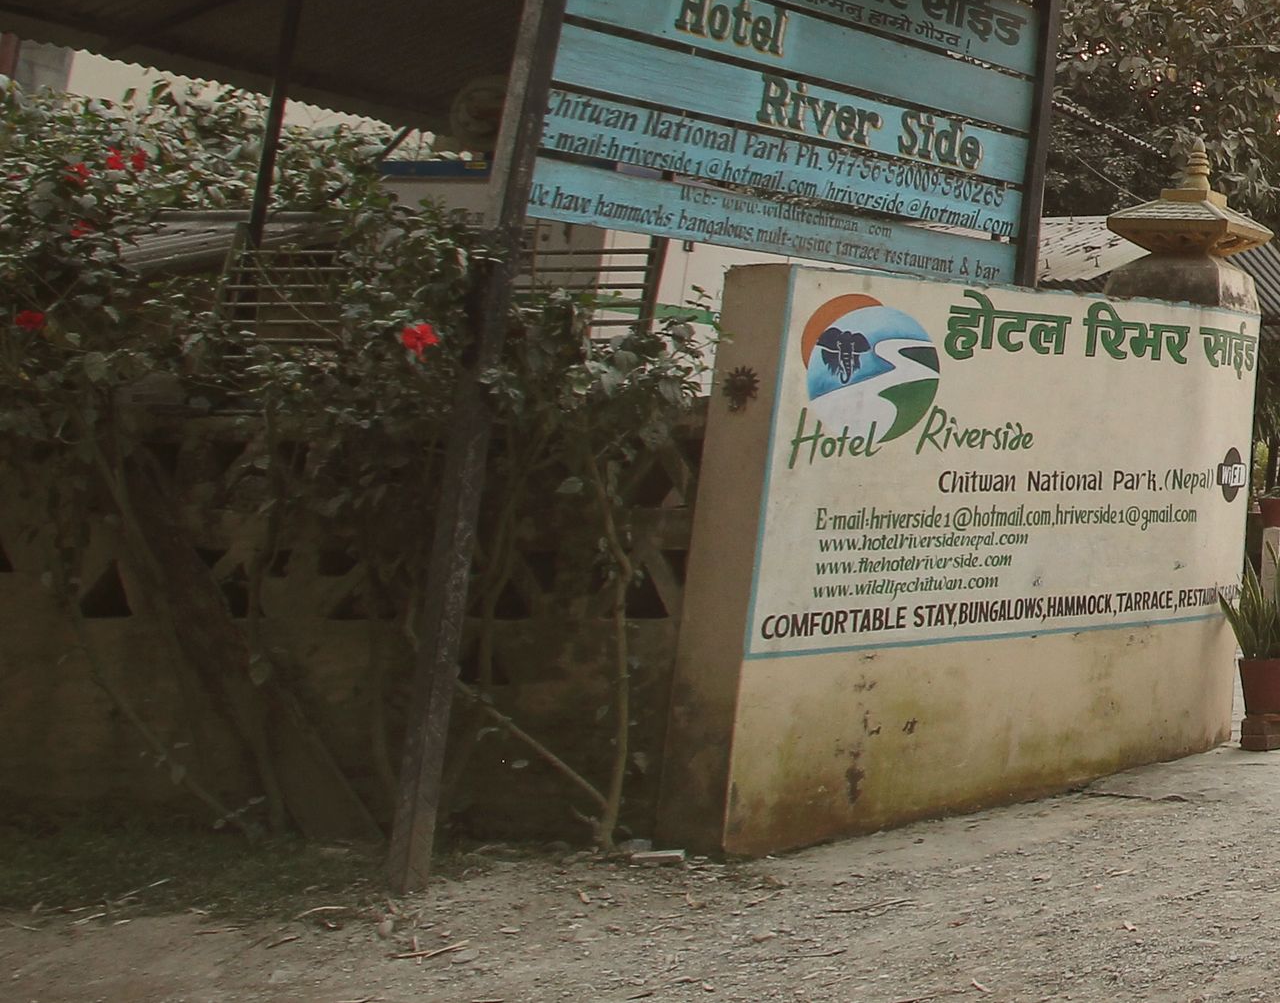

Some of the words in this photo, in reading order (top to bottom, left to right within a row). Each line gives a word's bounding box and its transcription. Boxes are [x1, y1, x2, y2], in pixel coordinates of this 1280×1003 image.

[642, 109, 738, 154] National
[740, 130, 788, 164] Park
[795, 144, 823, 171] Ph.
[757, 73, 883, 147] River
[898, 110, 984, 171] Side
[550, 185, 589, 214] have
[883, 246, 954, 274] restaurant
[959, 256, 968, 276] &
[975, 259, 1001, 281] bar
[944, 289, 1072, 360] होटल
[1084, 302, 1190, 364] रिभर
[1200, 321, 1257, 379] साईड
[788, 406, 883, 469] Hotel
[915, 405, 1035, 455] Riverside
[938, 470, 1016, 494] Chitwan
[1027, 469, 1103, 492] National
[815, 553, 1012, 575] www.thehotelriverside.com
[818, 532, 1028, 552] www.hotelriversidenepal.com
[813, 575, 999, 601] www.wildlifechitwan.com
[761, 606, 907, 640] COMFORTABLE
